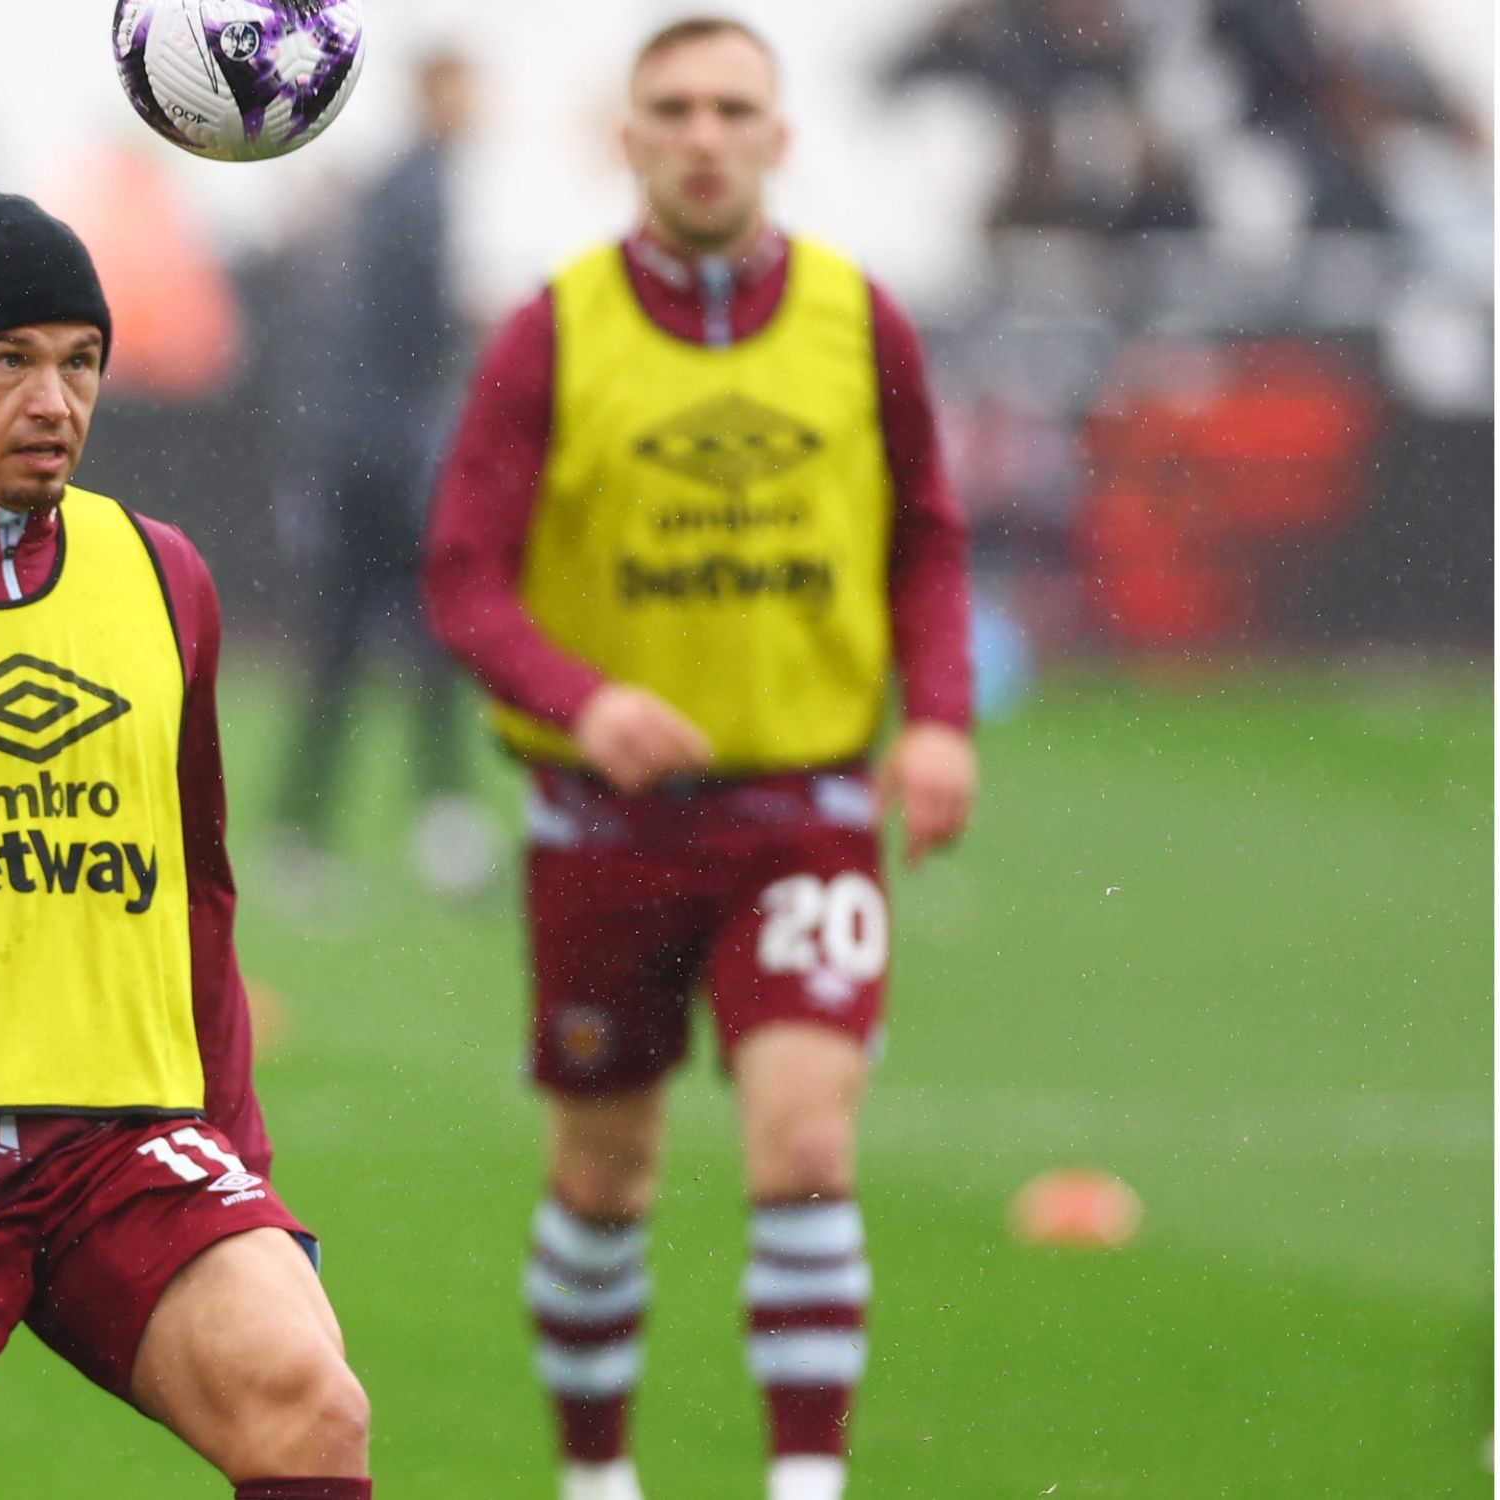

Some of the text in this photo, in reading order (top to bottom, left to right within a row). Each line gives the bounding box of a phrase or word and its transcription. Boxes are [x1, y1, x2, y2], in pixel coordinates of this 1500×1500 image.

[755, 871, 889, 980] 20
[136, 1126, 248, 1183] 11
[221, 1188, 266, 1206] umbro
